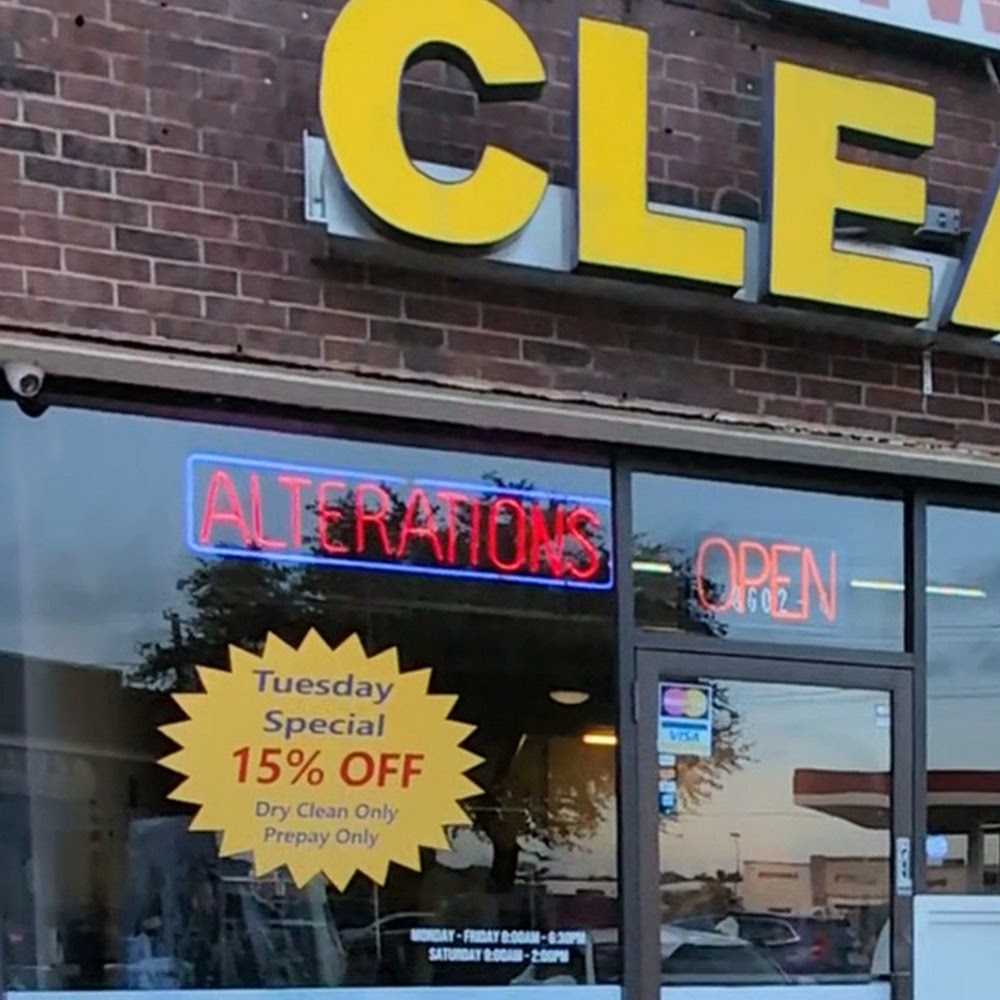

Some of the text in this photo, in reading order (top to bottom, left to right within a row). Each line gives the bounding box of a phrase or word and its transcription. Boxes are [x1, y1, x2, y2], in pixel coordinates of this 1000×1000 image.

[200, 470, 600, 580] ALTERATIONS
[696, 536, 837, 622] OPEN
[252, 669, 395, 705] Tuesday
[263, 710, 385, 739] Special
[232, 746, 425, 789] 15% OFF
[255, 801, 399, 823] Dry Clean Only
[263, 827, 379, 849] Prepay Only
[464, 928, 500, 944] FRIDAY
[429, 947, 483, 962] SATURDAY
